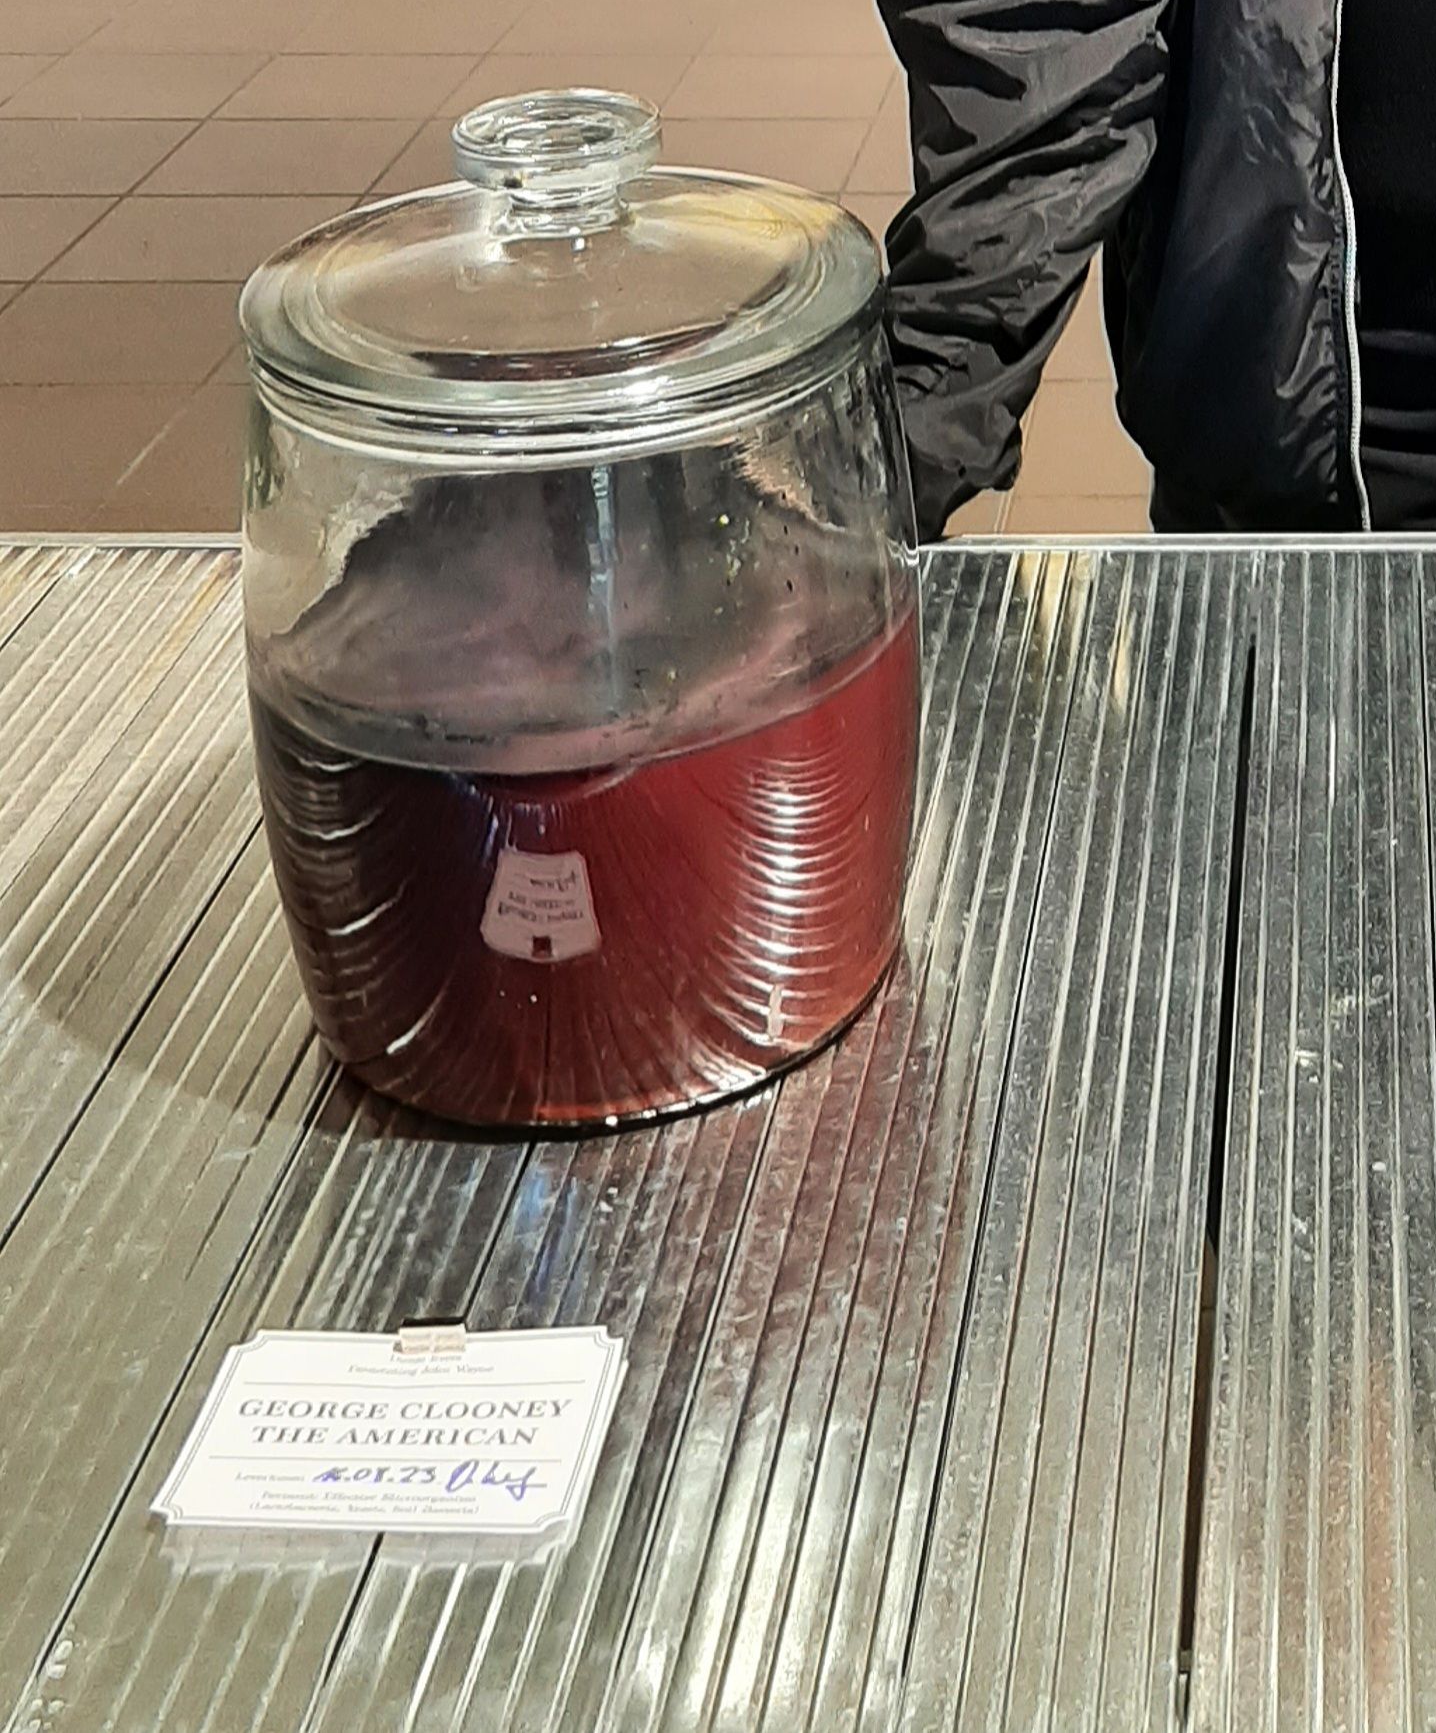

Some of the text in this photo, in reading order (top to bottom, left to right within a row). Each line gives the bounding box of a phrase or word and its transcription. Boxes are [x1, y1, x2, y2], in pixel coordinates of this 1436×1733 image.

[239, 1399, 572, 1420] GEORGE CLOONEY
[251, 1426, 539, 1446] THE AMERICAN
